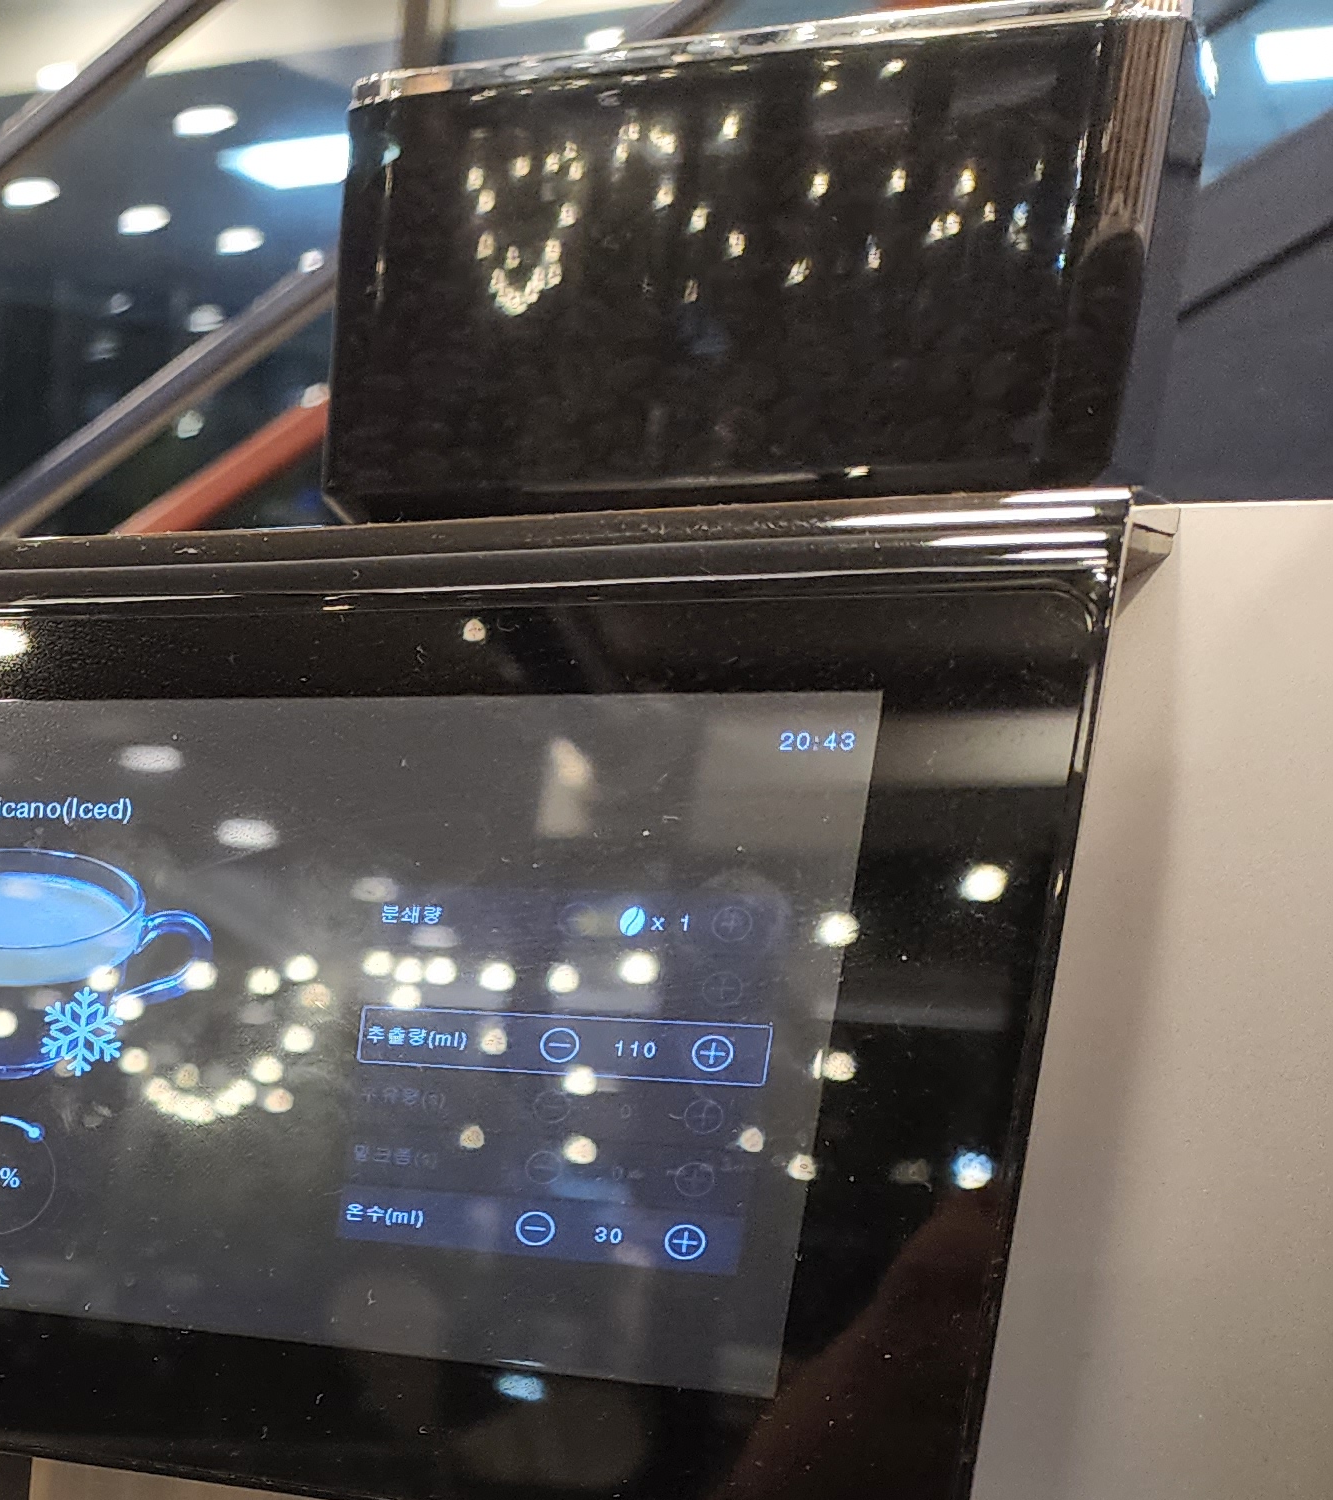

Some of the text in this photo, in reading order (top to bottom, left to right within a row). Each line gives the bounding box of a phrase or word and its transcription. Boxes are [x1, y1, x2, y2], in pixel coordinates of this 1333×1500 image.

[779, 731, 856, 752] 20:43
[681, 913, 691, 932] 1
[366, 1024, 468, 1051] 추출량(ml)
[615, 1038, 657, 1059] 110
[345, 1201, 425, 1229] 온수(ml)
[595, 1226, 622, 1245] 30
